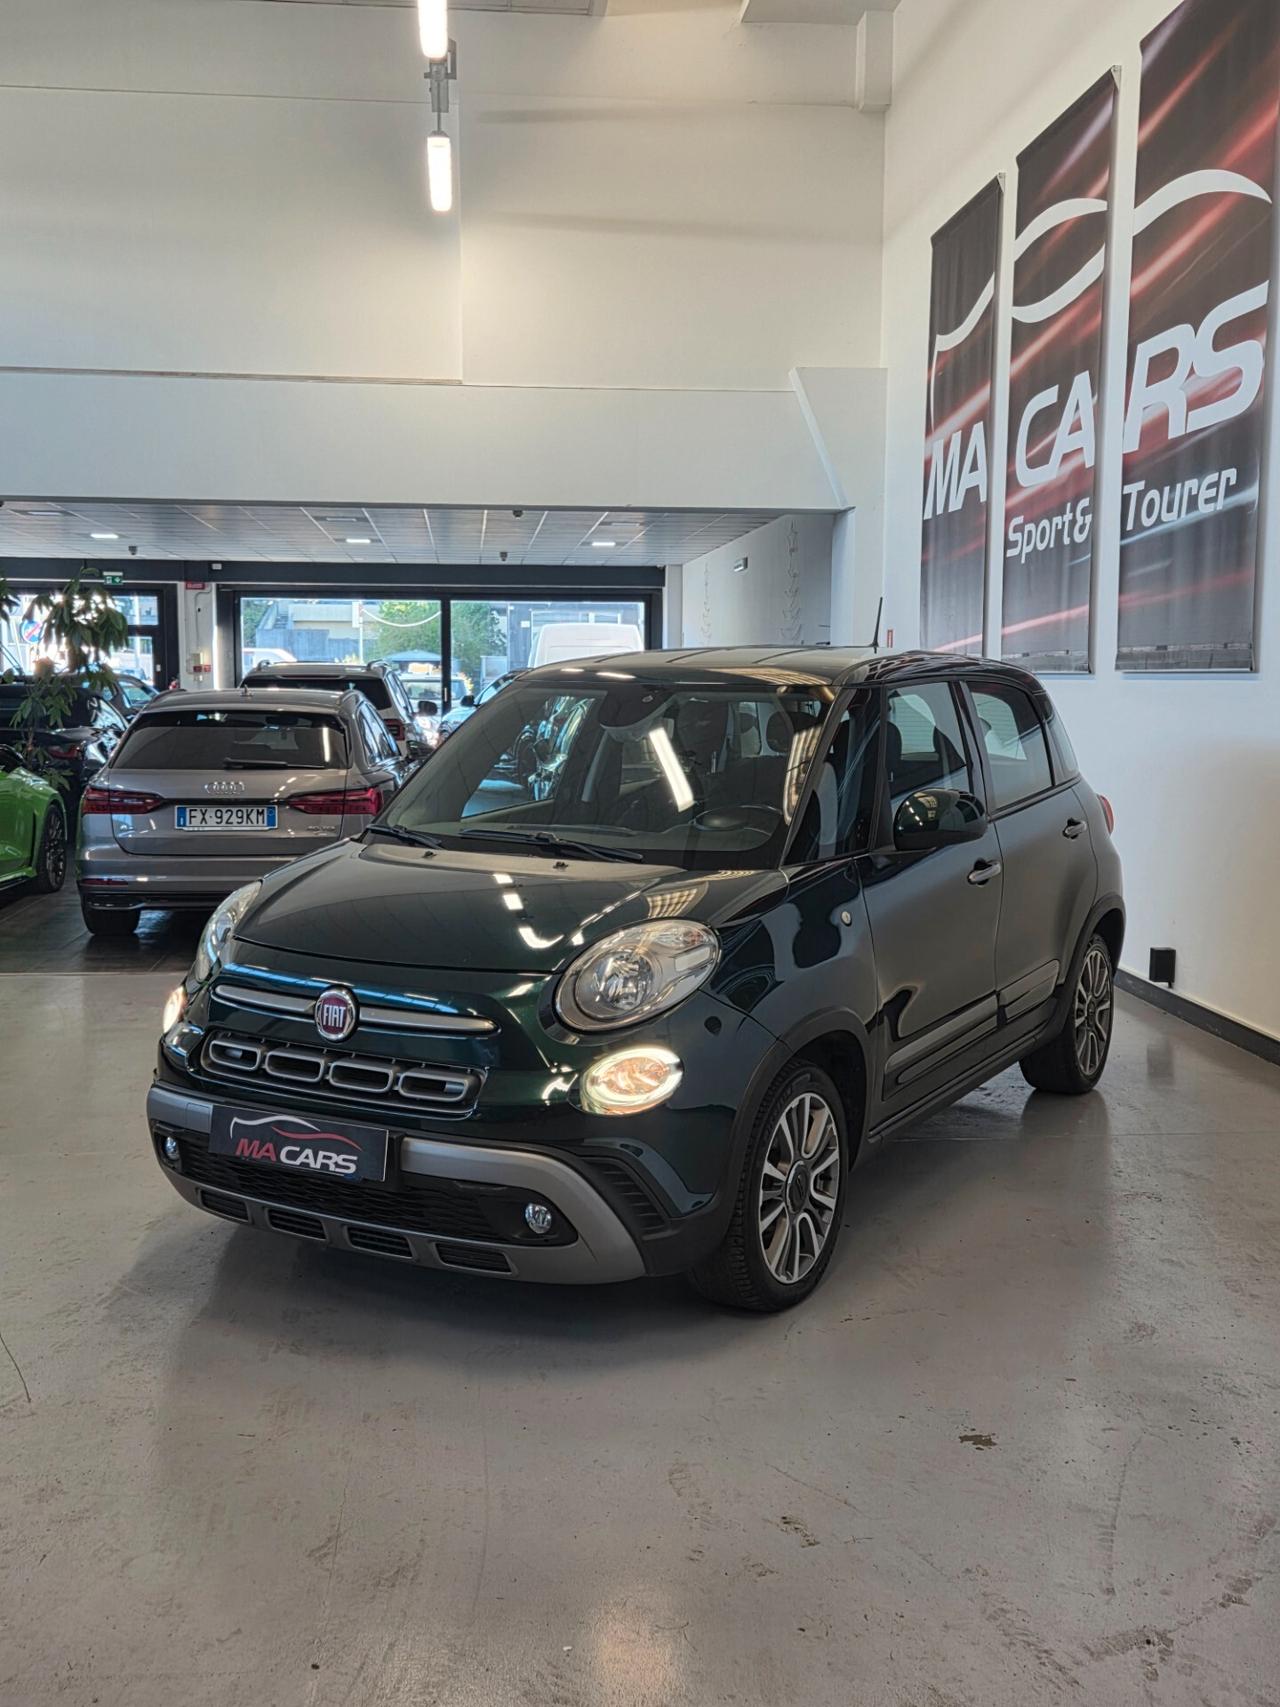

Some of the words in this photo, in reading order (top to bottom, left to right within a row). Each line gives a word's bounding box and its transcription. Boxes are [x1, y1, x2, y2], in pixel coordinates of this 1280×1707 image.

[923, 421, 988, 520] MA
[323, 1004, 347, 1027] FIAT
[235, 1138, 276, 1162] MA
[280, 1146, 358, 1174] CARS
